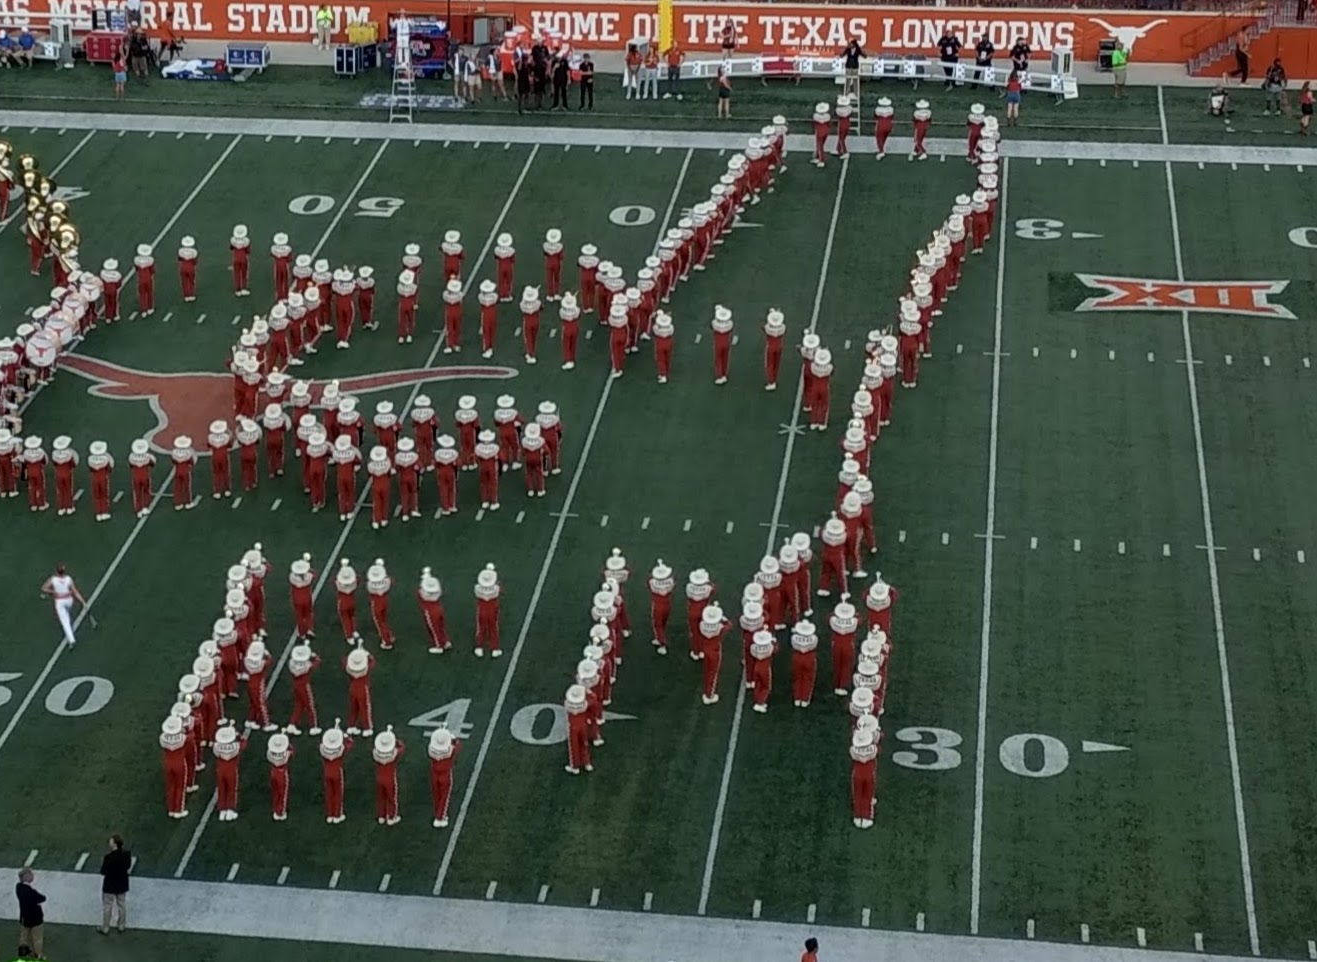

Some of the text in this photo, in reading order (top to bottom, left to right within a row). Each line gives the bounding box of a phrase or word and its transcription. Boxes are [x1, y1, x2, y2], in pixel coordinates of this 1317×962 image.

[530, 11, 620, 42] HOME
[683, 14, 749, 44] THE
[759, 15, 868, 48] TEXAS
[882, 18, 1075, 51] LONGHORNS
[889, 732, 1069, 778] 30
